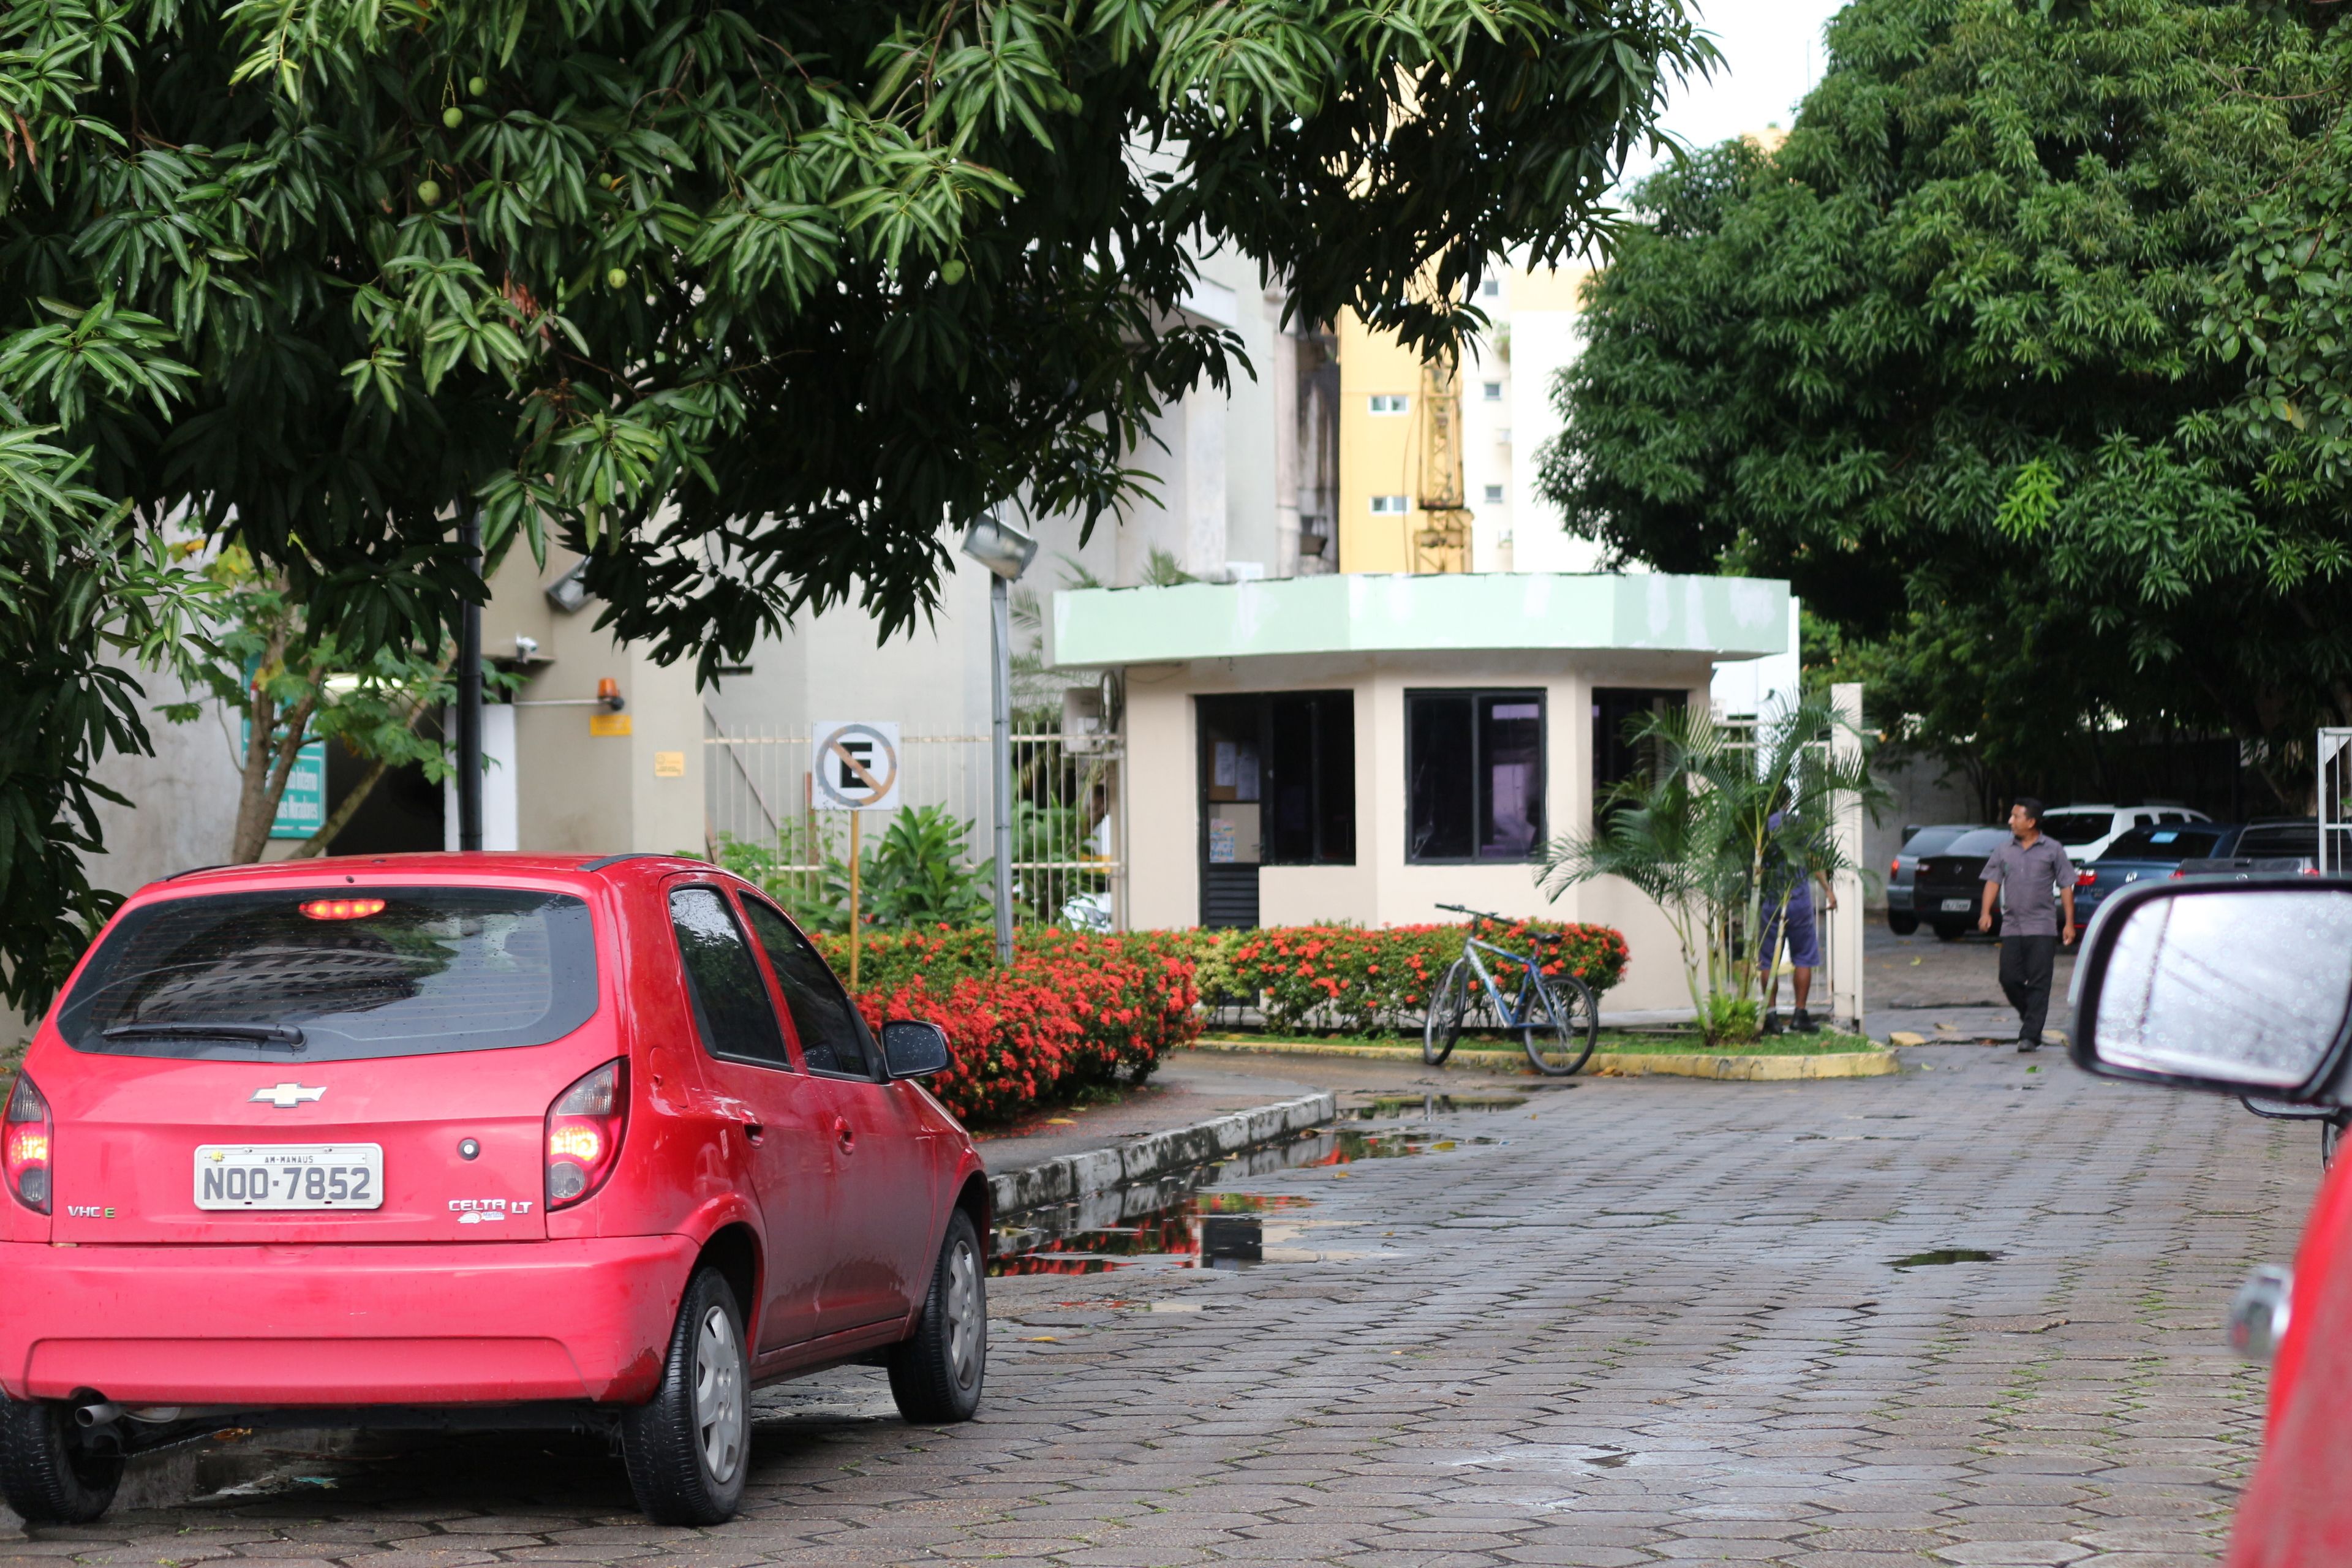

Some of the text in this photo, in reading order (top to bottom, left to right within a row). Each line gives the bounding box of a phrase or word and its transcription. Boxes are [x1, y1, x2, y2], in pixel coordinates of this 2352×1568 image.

[840, 742, 872, 788] E
[67, 1205, 115, 1218] VHC E
[448, 1199, 533, 1213] CELTA LT
